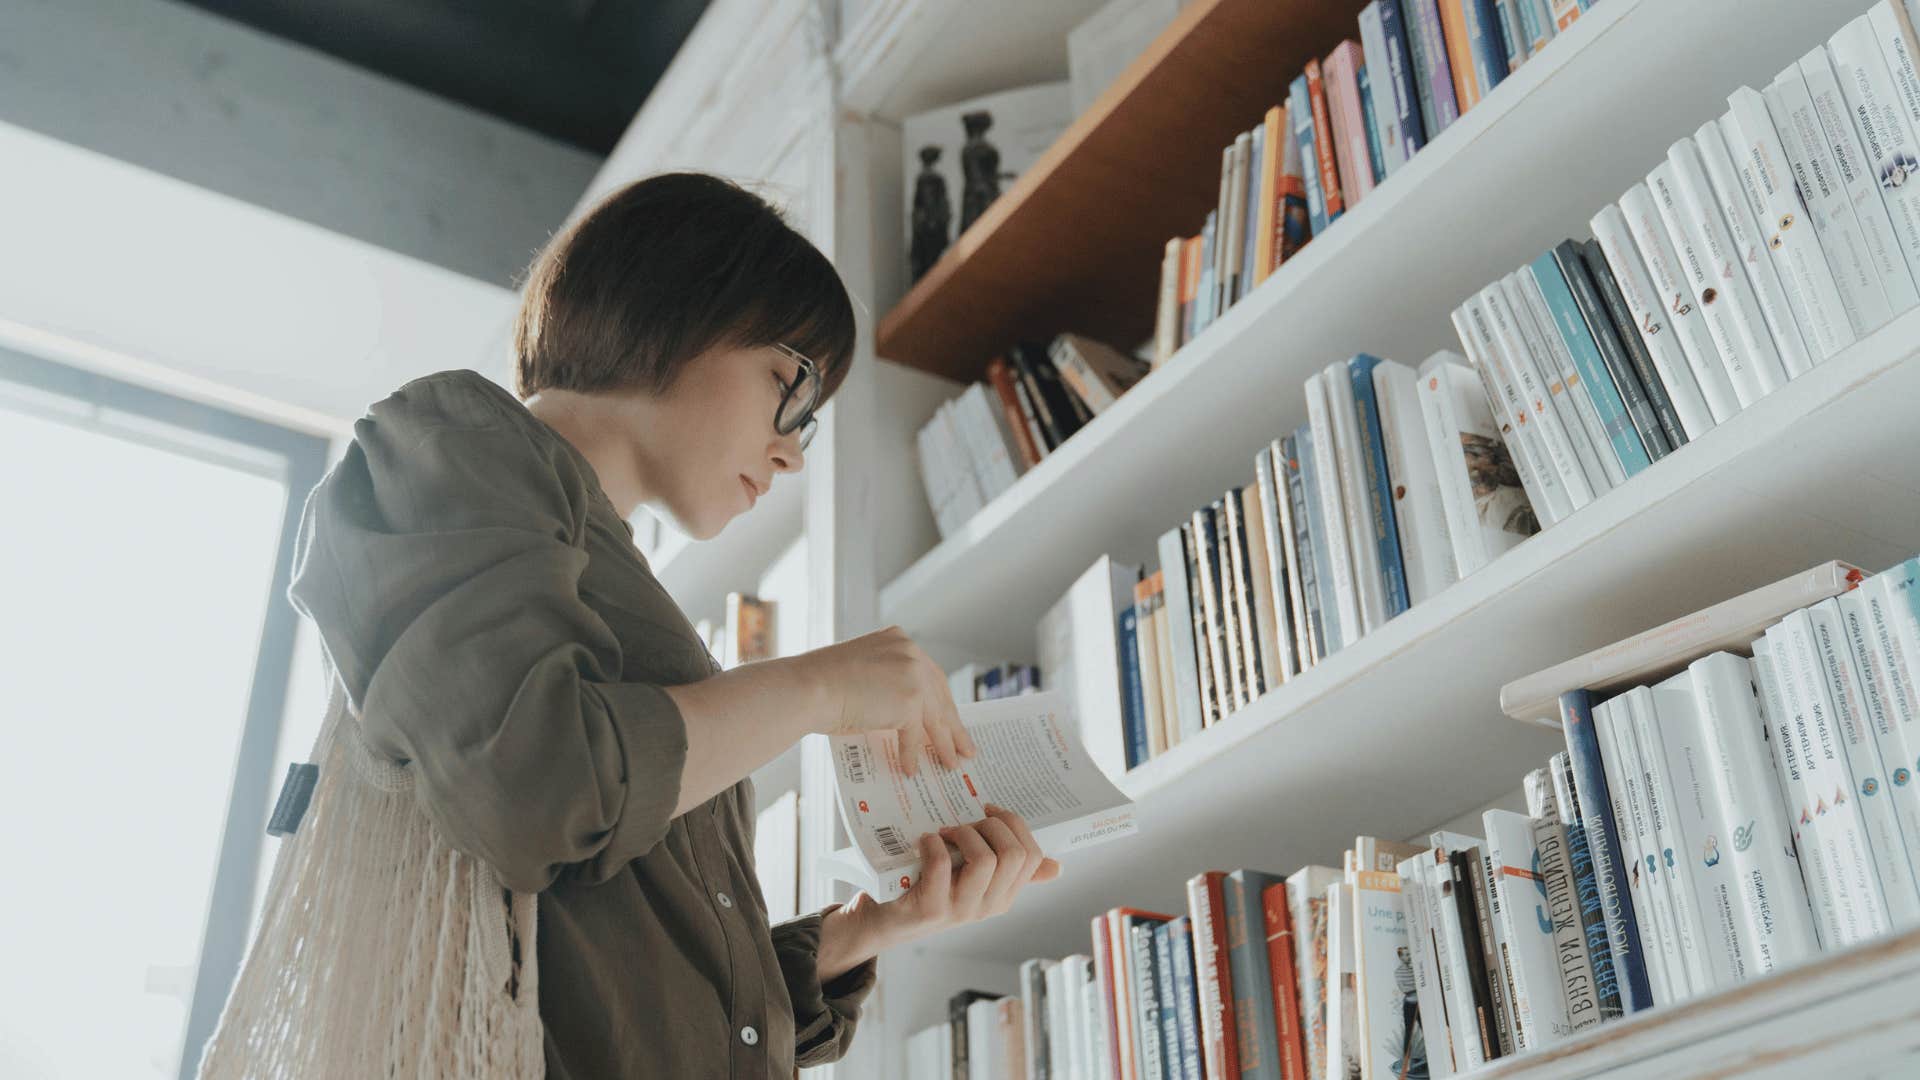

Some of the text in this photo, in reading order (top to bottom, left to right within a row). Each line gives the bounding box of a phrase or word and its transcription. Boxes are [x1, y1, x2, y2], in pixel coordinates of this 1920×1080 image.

[1779, 722, 1800, 781] АРТ-ТЕРАПИЯ:
[1083, 830, 1105, 841] FLEURS
[1107, 826, 1118, 834] DU
[1484, 855, 1493, 876] BACK
[1488, 877, 1497, 898] ROAD
[1537, 833, 1577, 931] ЖЕНЩИНЫ
[1586, 813, 1631, 956] ИСКУССТВОТЕРАПИЯ
[1368, 906, 1393, 918] Une
[1558, 936, 1593, 1014] ВНУТРИ
[1584, 920, 1619, 999] ВНУТРИ
[1490, 973, 1501, 1003] ORWELL
